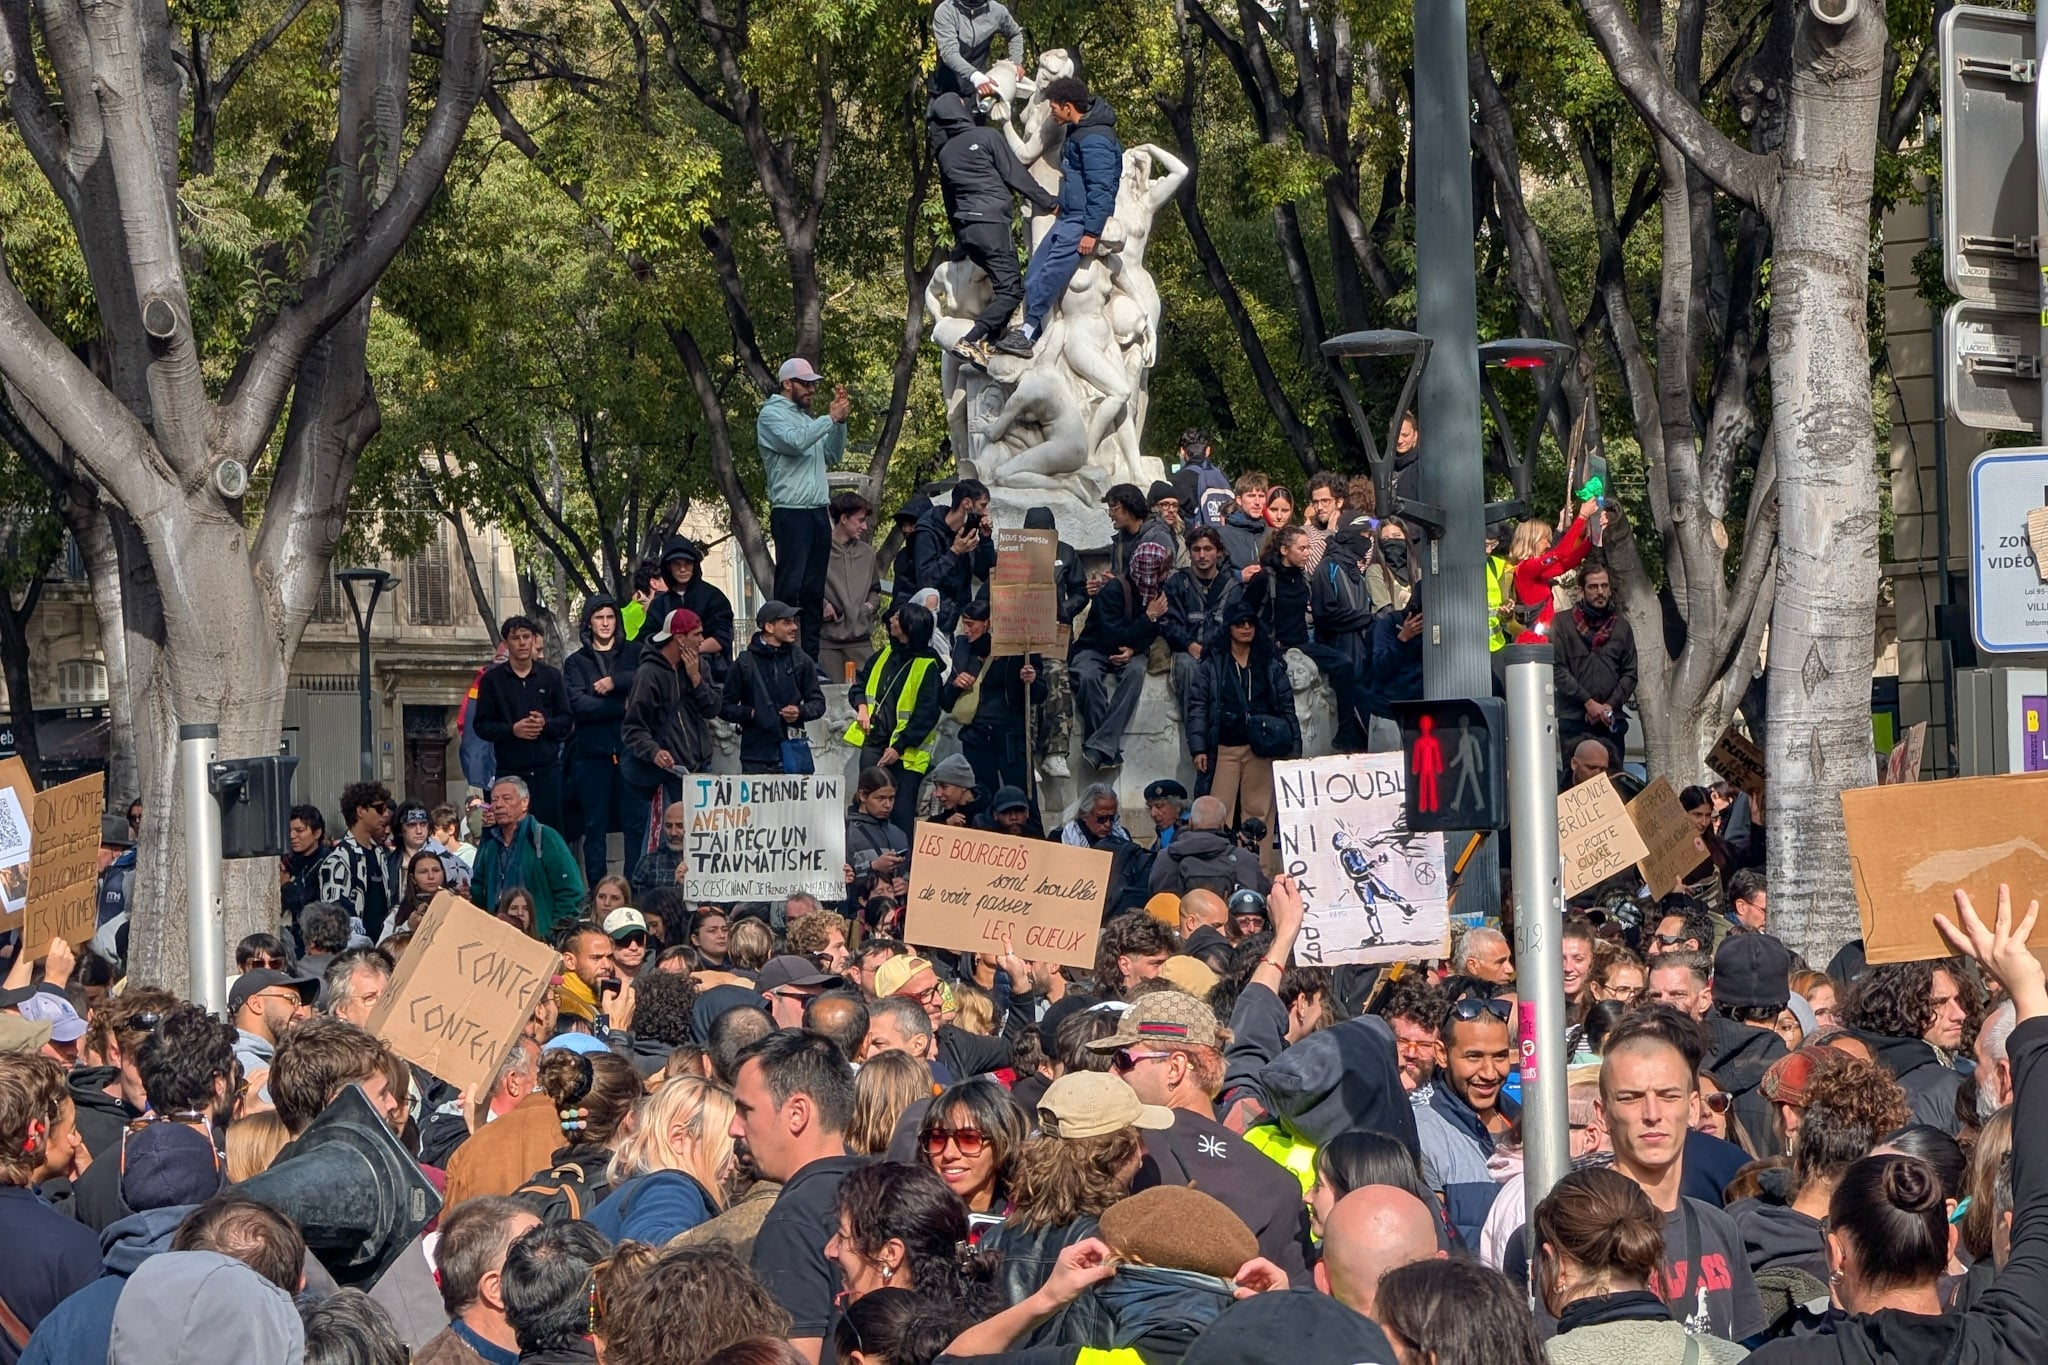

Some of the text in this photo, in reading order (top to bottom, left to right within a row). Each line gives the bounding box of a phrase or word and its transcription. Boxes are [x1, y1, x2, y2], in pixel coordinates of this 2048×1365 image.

[2027, 602, 2048, 611] VILL
[740, 776, 810, 804] DEMANDÉ
[816, 780, 836, 799] UN
[1280, 770, 1319, 808] NI
[1564, 776, 1610, 814] MONDE
[34, 790, 103, 834] ON COMPTE
[692, 803, 751, 832] AVENIR
[31, 836, 57, 868] LES
[782, 826, 807, 848] UN
[918, 834, 1029, 870] LES BOURGEOIS
[1283, 824, 1316, 855] NI
[1576, 824, 1619, 857] DROITE
[1570, 872, 1589, 891] LE
[1592, 851, 1626, 879] GAZ
[1577, 843, 1612, 870] OUVRE
[986, 873, 1030, 892] sont
[917, 884, 1033, 918] de voir passer
[26, 908, 50, 949] LES
[982, 918, 1087, 952] LES GUEUX
